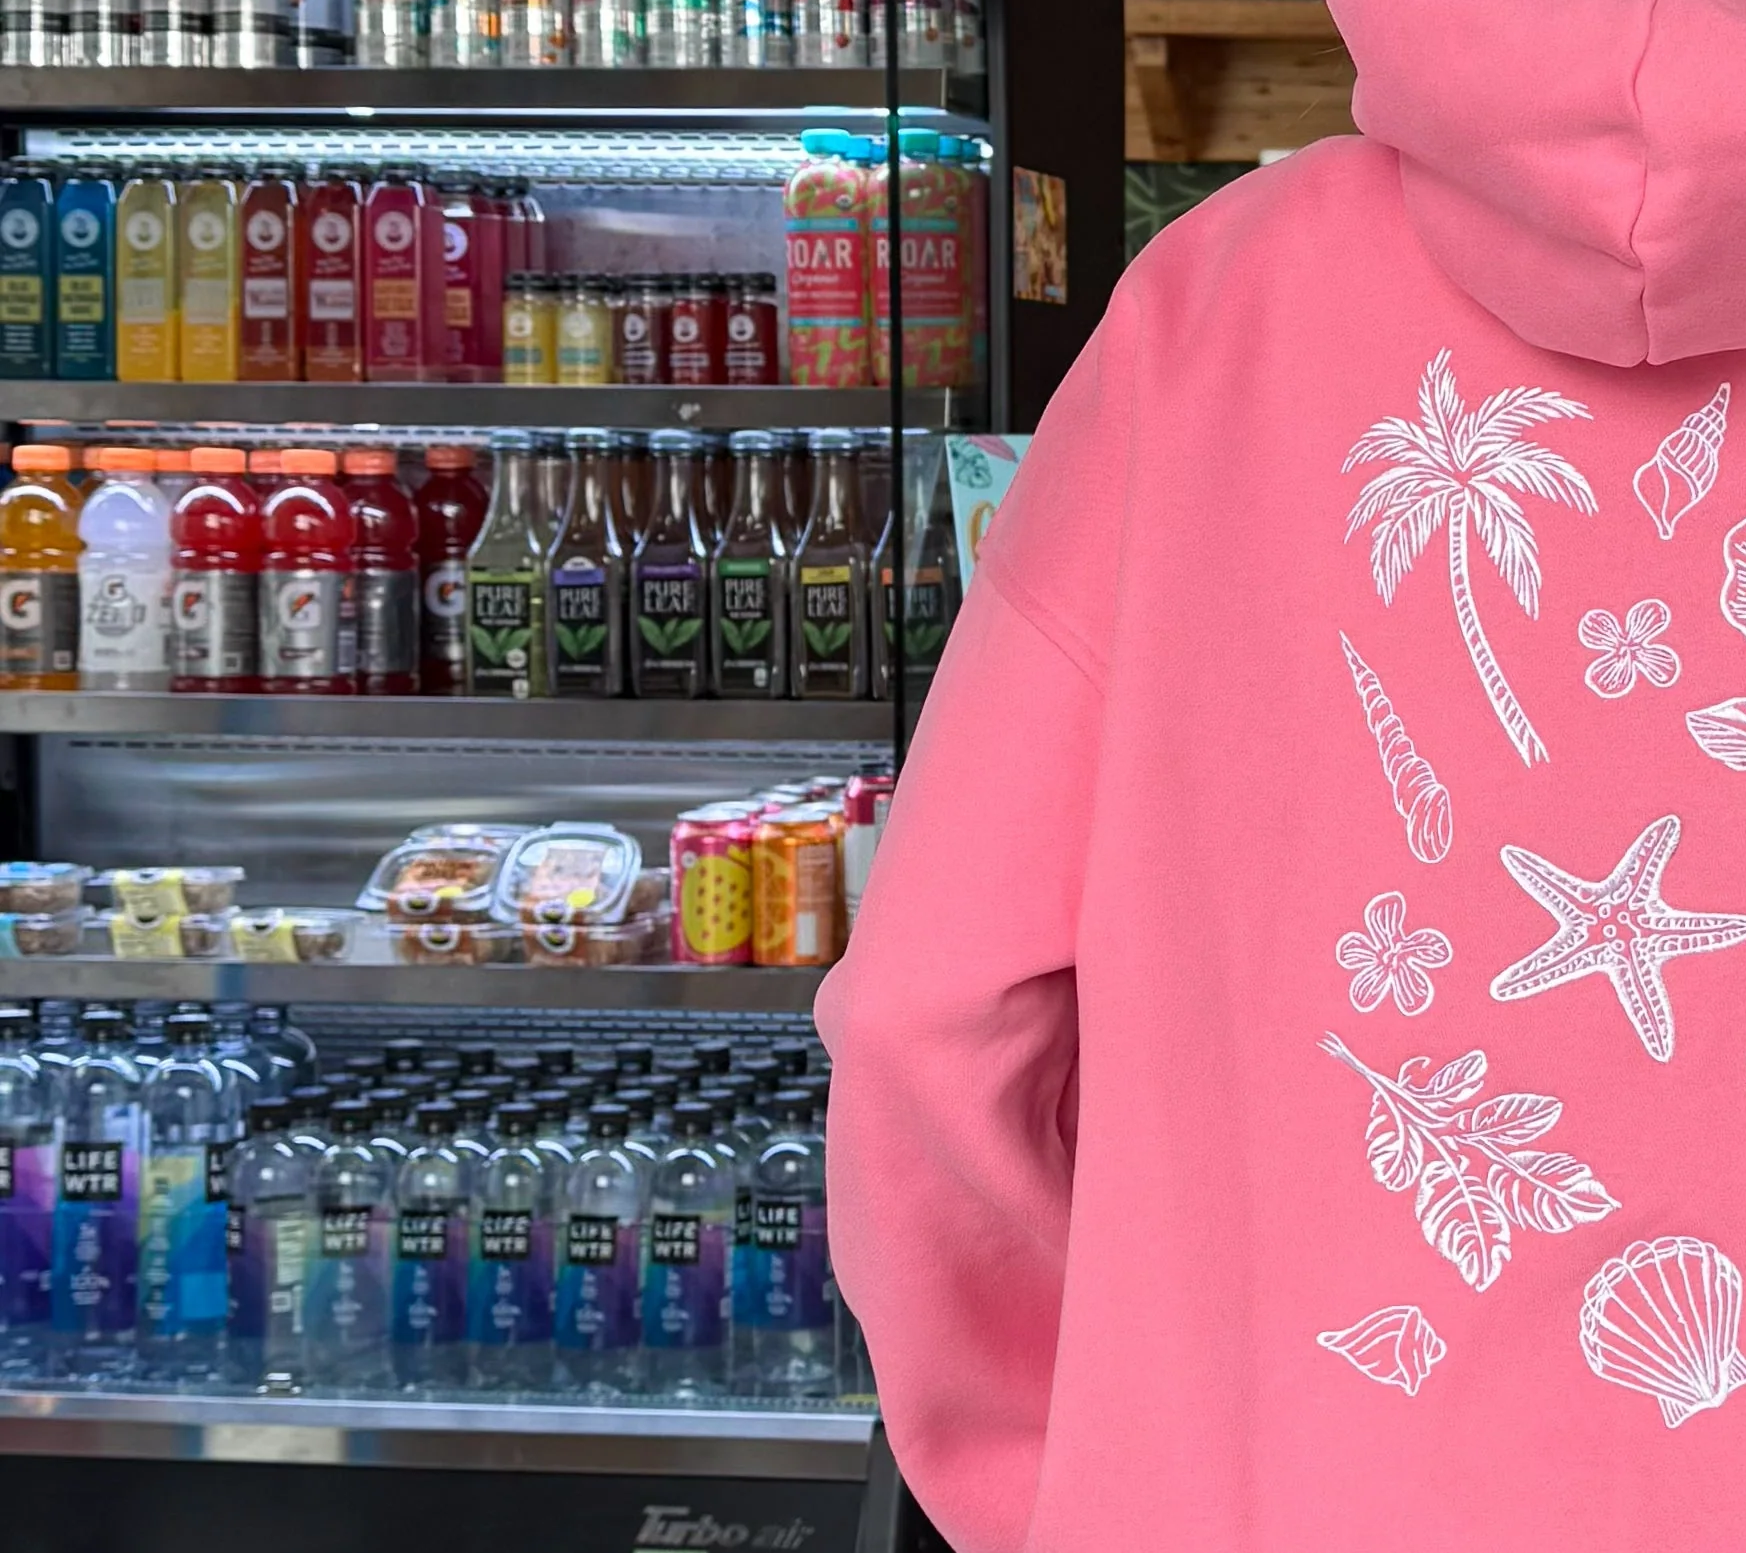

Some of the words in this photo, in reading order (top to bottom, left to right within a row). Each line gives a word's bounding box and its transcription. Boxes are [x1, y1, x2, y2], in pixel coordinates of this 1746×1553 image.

[475, 585, 525, 600] PURE
[559, 588, 601, 602] PURE
[644, 581, 694, 597] PURE
[725, 578, 764, 595] PURE
[807, 586, 847, 601] PURE
[65, 1151, 117, 1170] LIFE
[325, 1212, 367, 1231] LIFE
[758, 1207, 798, 1224] LIFE
[402, 1216, 444, 1233] LIFE
[484, 1216, 528, 1234] LIFE
[571, 1223, 612, 1239] LIFE
[654, 1221, 697, 1239] LIFE
[635, 1504, 750, 1548] Turbo
